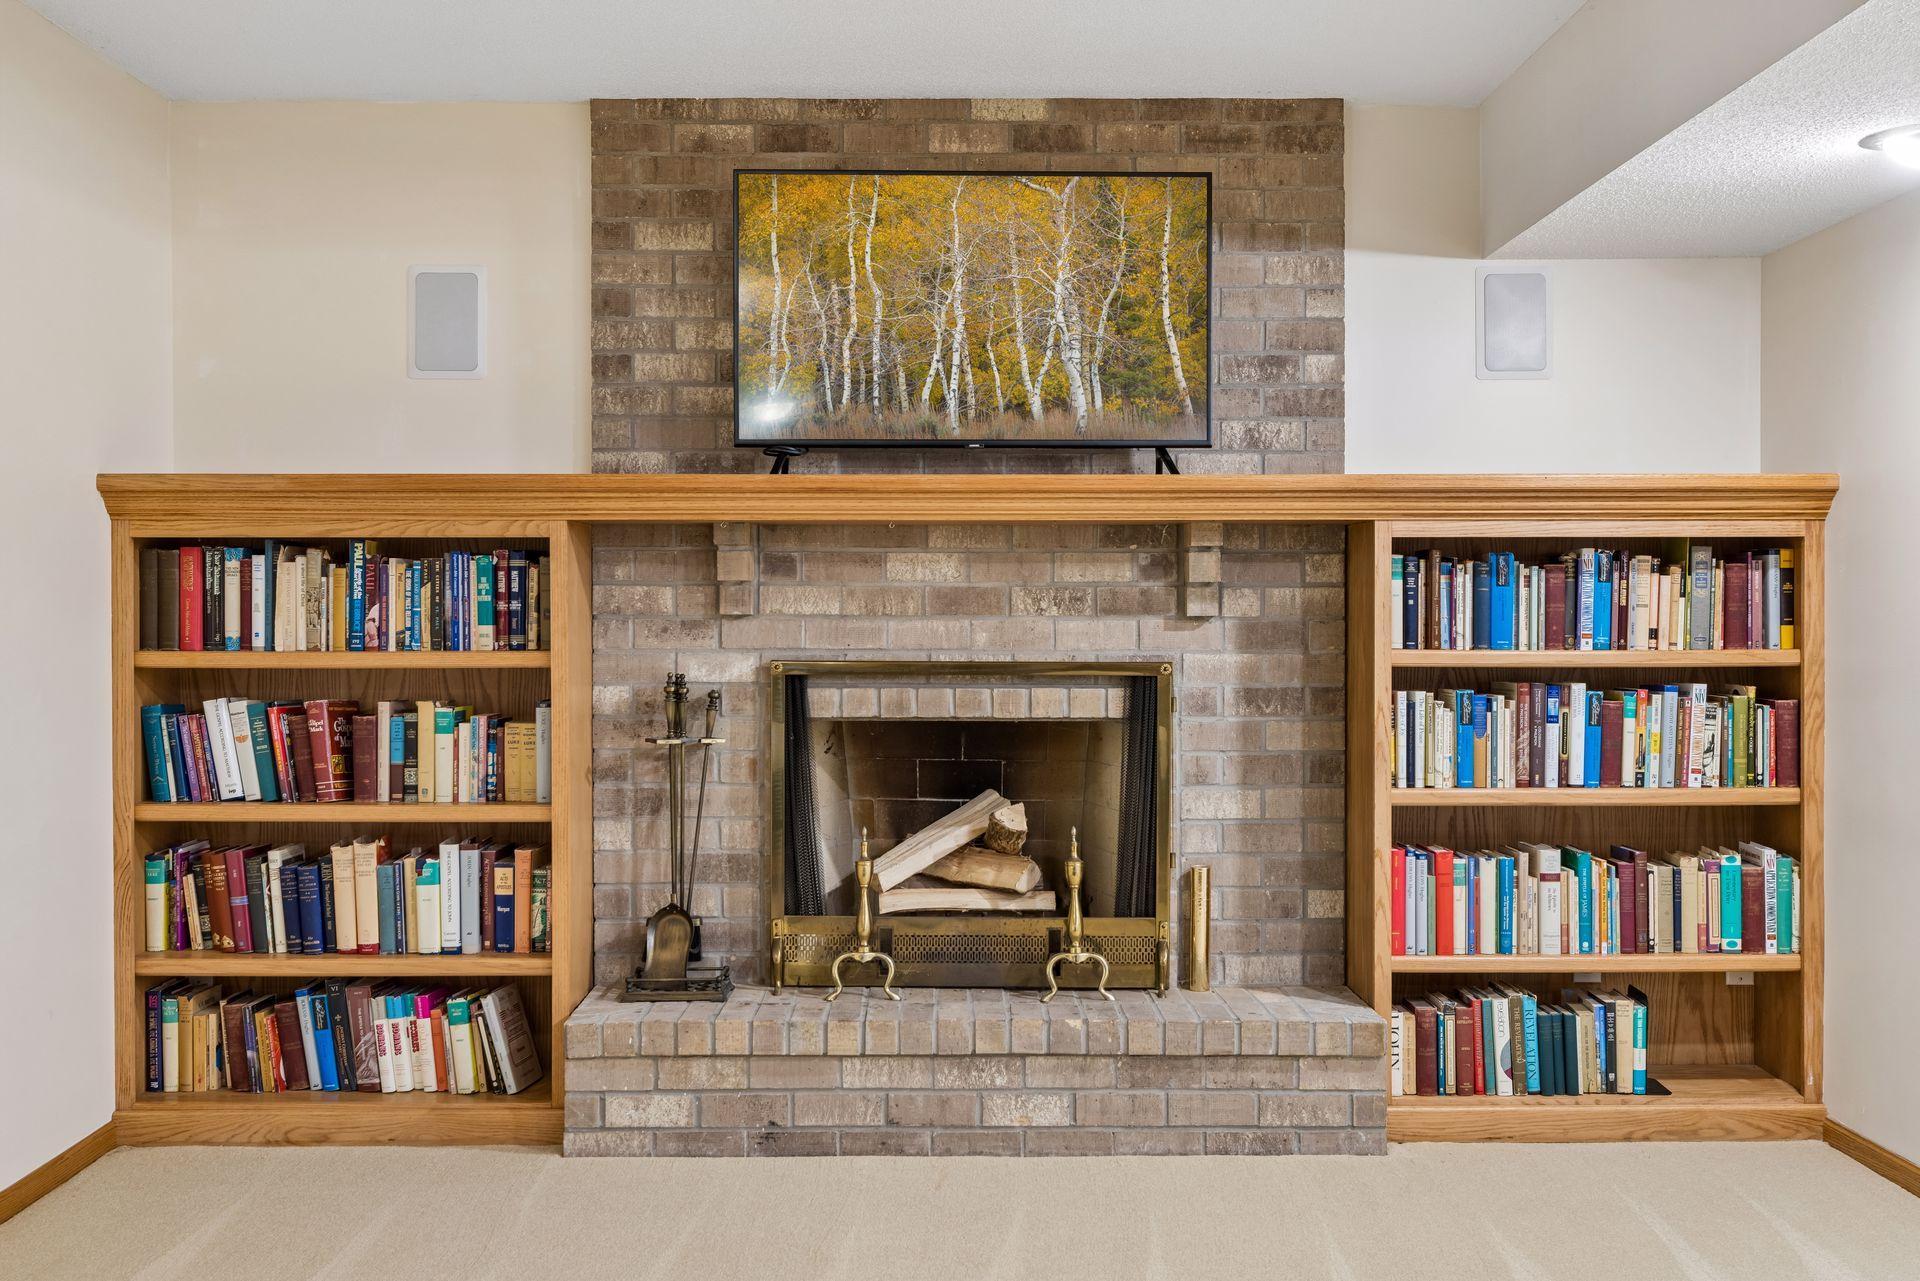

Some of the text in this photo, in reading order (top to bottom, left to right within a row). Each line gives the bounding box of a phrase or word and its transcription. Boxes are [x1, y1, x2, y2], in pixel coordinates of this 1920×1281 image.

[354, 543, 363, 568] PAUL
[1583, 559, 1593, 570] NIV
[366, 564, 375, 592] PAUL
[1582, 570, 1593, 632] APPLICATION COMMENTARY
[1696, 693, 1705, 704] NIV
[1766, 870, 1776, 933] APPLICATION COMMENTARY
[1497, 1002, 1506, 1039] revelation
[376, 1024, 387, 1057] ROMANS
[391, 1023, 402, 1056] ROMANS
[1515, 1022, 1523, 1062] REVELATION
[1525, 1009, 1537, 1081] REVELATION
